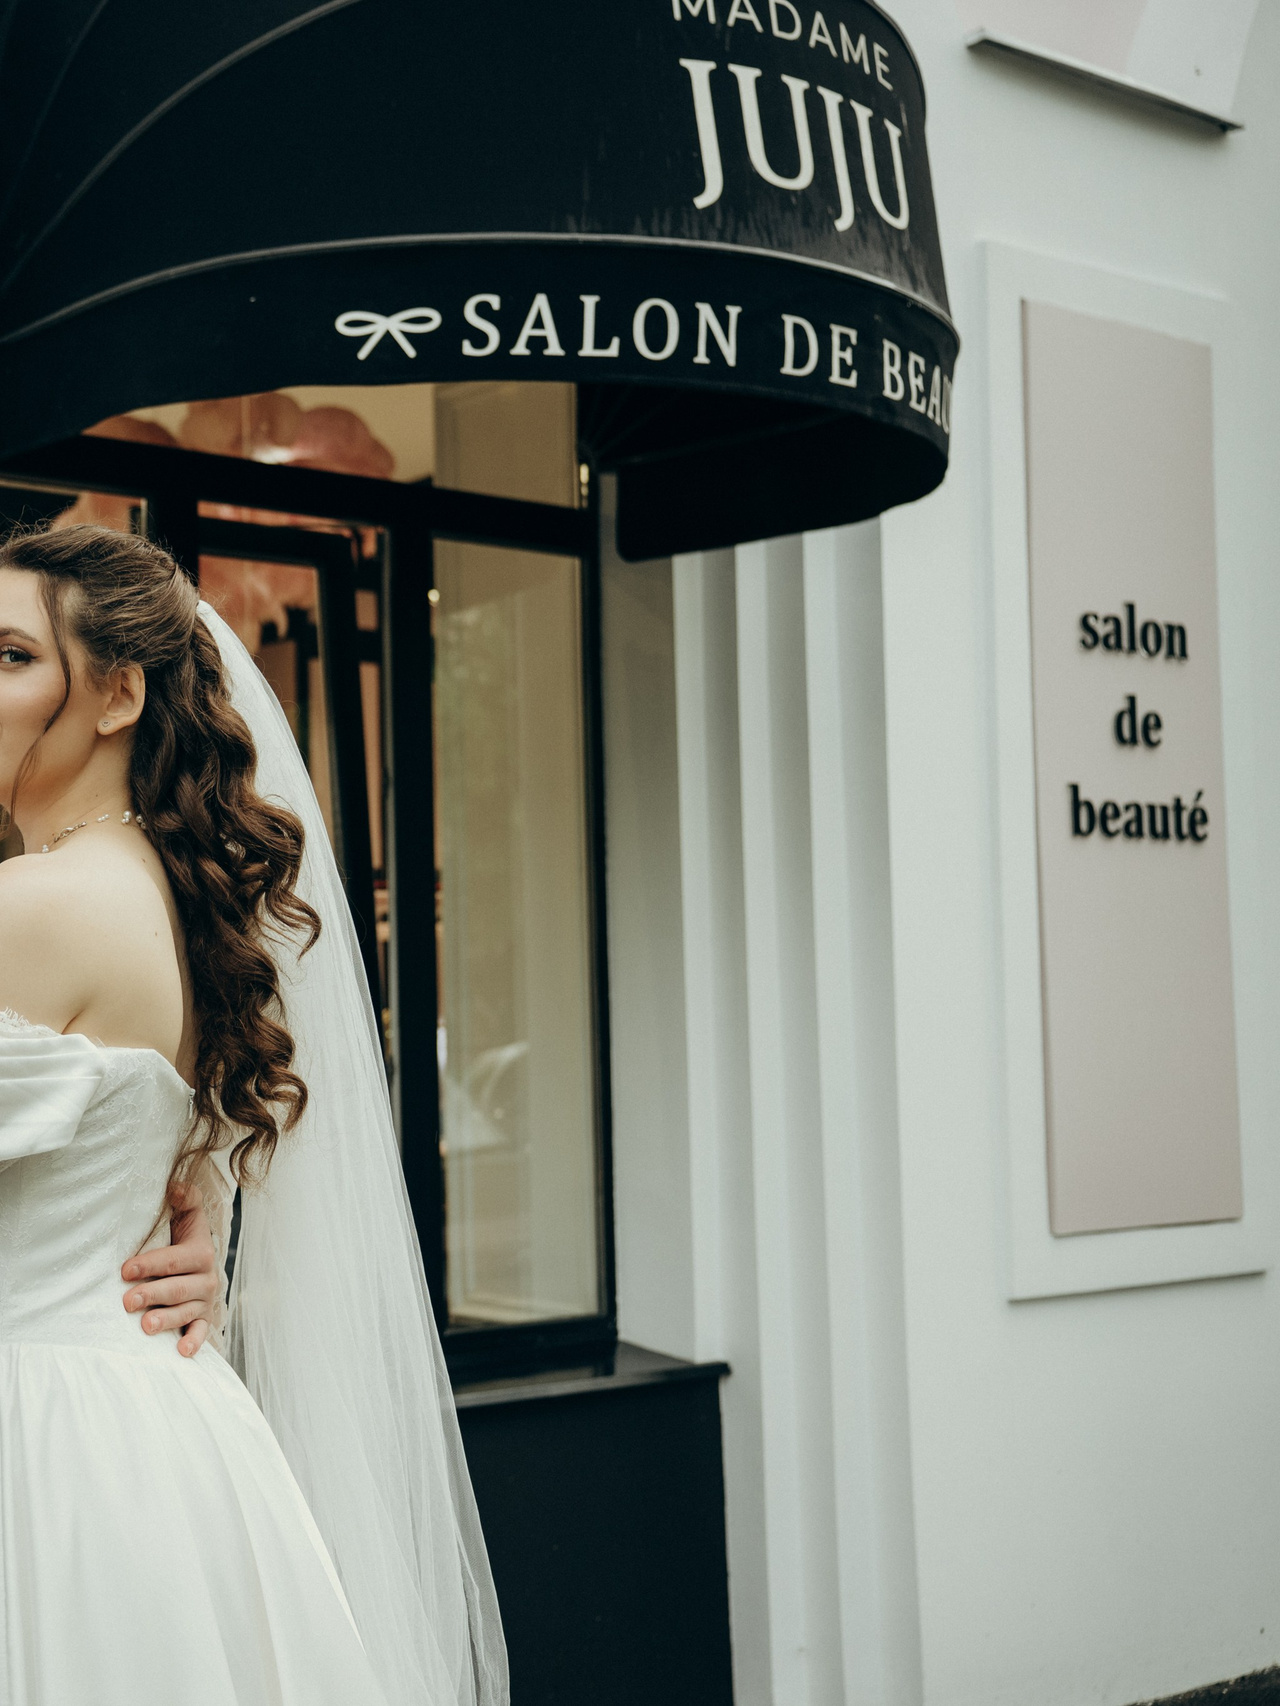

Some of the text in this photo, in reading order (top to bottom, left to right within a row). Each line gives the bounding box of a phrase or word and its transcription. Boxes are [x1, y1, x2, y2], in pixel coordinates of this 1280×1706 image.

[672, 0, 893, 91] MADAME
[678, 57, 910, 232] JUJU
[461, 293, 742, 367] SALON
[780, 314, 858, 389] DE
[1079, 602, 1188, 660] salon
[1114, 695, 1163, 749] de
[1067, 783, 1209, 843] beauté
